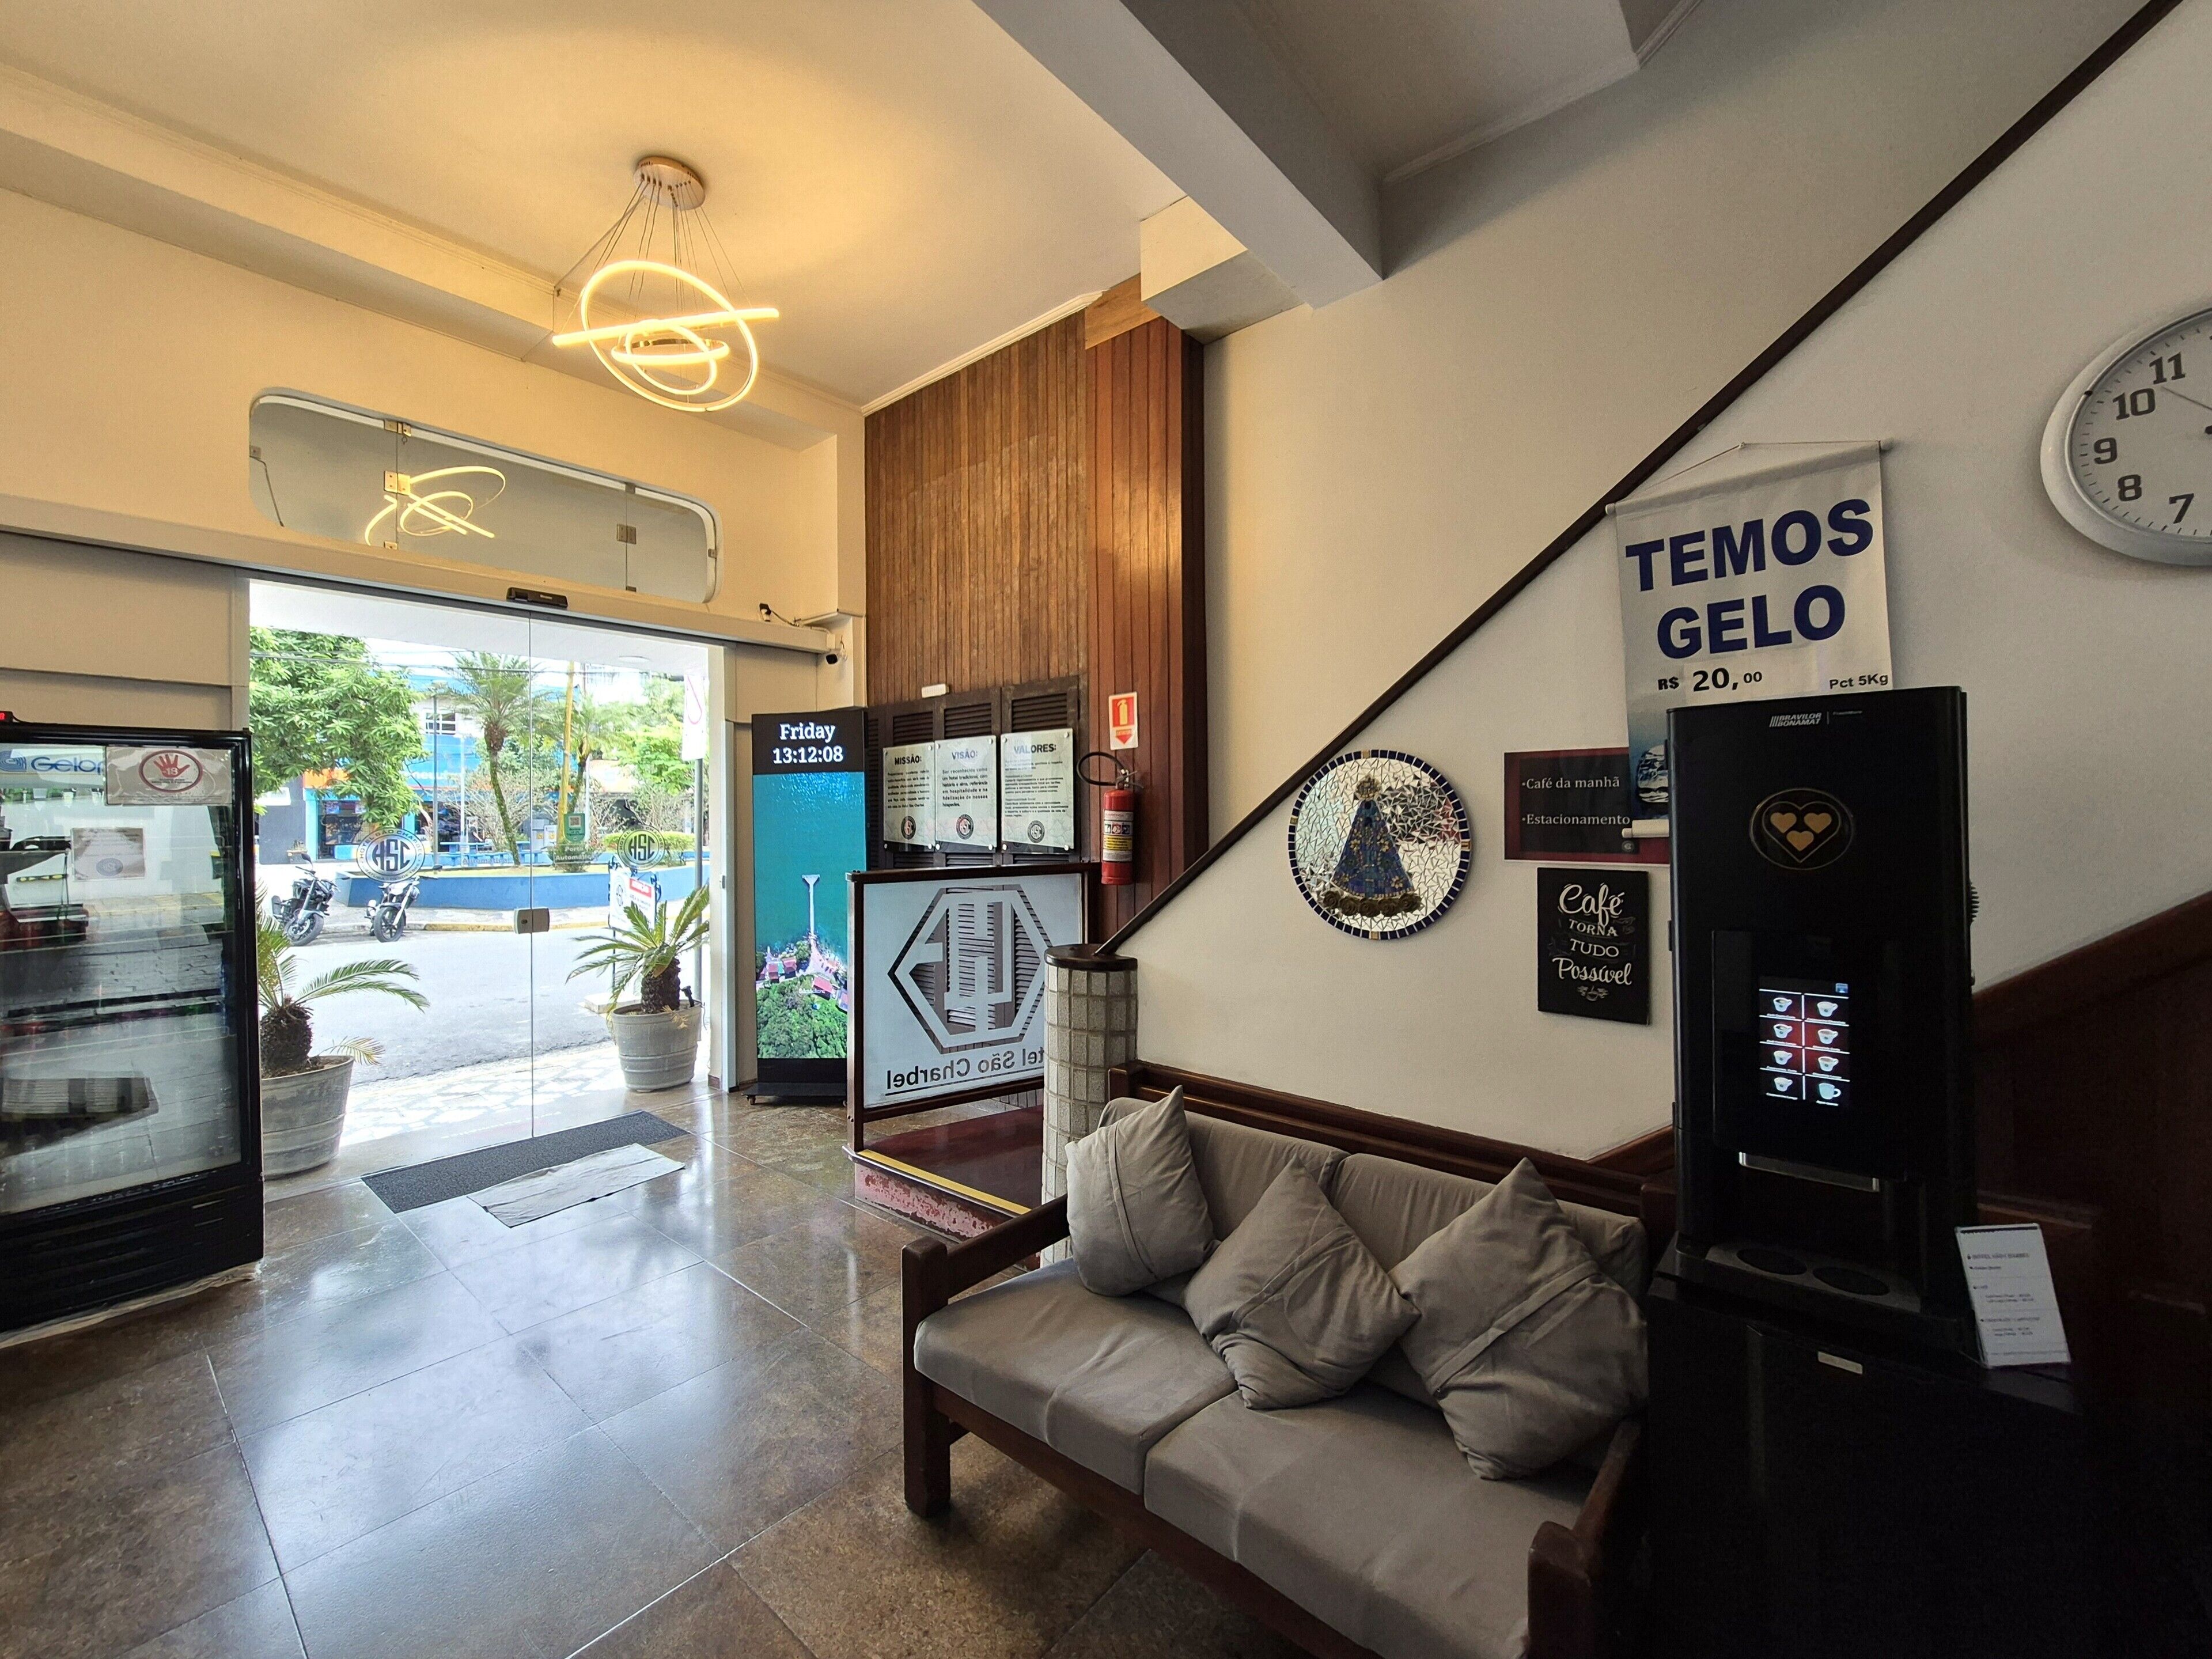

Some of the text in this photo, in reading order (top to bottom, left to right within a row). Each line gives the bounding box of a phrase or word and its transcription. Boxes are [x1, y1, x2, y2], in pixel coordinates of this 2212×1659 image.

[2149, 351, 2186, 384] 11
[2112, 388, 2156, 420] 10
[2093, 437, 2118, 464] 9
[2118, 474, 2142, 502] 8
[2169, 493, 2195, 524] 7
[1625, 498, 1873, 592] TEMOS
[1657, 584, 1846, 659] GELO
[1658, 676, 1680, 690] R$
[1830, 677, 1854, 690] Pct
[1858, 673, 1889, 688] 5Kg
[779, 722, 836, 743] Friday
[772, 745, 843, 764] 13:12:08
[894, 754, 922, 765] MISSÃO:
[952, 748, 978, 760] VISÃO:
[1014, 743, 1056, 754] VALORES:
[1526, 777, 1620, 789] Café da manhã
[1526, 814, 1630, 825] Estacionamento
[372, 839, 411, 872] HSC
[628, 834, 655, 861] HSC
[1559, 884, 1625, 927] Café
[1569, 919, 1618, 937] TORNA
[1570, 938, 1619, 957] TUDO
[1552, 957, 1633, 985] Possível
